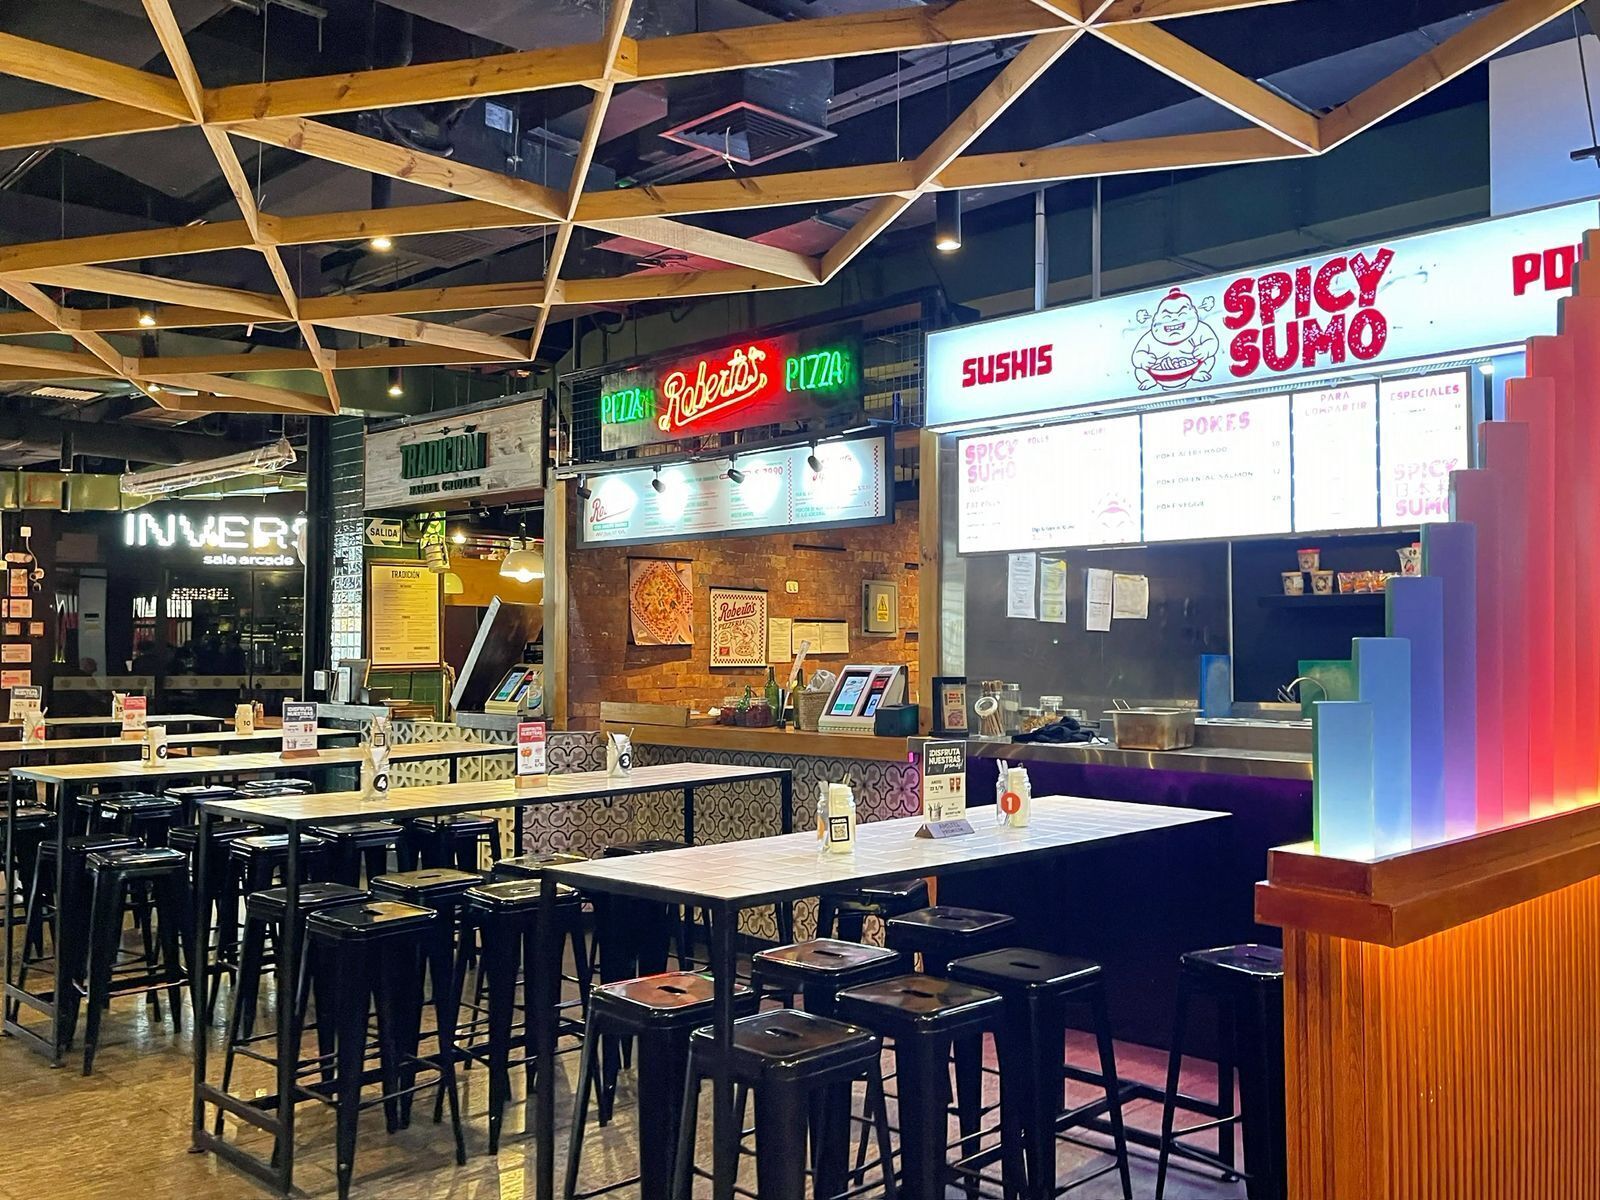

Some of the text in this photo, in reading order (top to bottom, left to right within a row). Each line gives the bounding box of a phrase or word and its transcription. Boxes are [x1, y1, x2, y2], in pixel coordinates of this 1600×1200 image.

[1512, 242, 1584, 296] PO
[1223, 248, 1395, 330] SPICY
[1229, 309, 1388, 378] SUMO
[786, 351, 844, 393] PIZZA
[962, 344, 1053, 388] SUSHIS
[1320, 391, 1350, 402] PARA
[1390, 385, 1459, 401] ESPECIALES
[602, 388, 644, 424] PIZZA
[1305, 401, 1367, 417] COMPARTIR
[1183, 411, 1250, 436] POKES
[965, 439, 1019, 465] SPICY
[967, 460, 1017, 484] SUMO
[1394, 458, 1459, 481] SPICY
[370, 526, 398, 538] SALIDA
[203, 554, 294, 567] sala arcade
[718, 601, 757, 622] Roberto's
[160, 747, 167, 757] 9
[622, 754, 630, 767] 3
[929, 755, 961, 765] NUESTRAS
[377, 776, 387, 789] 4
[1007, 796, 1013, 811] 1
